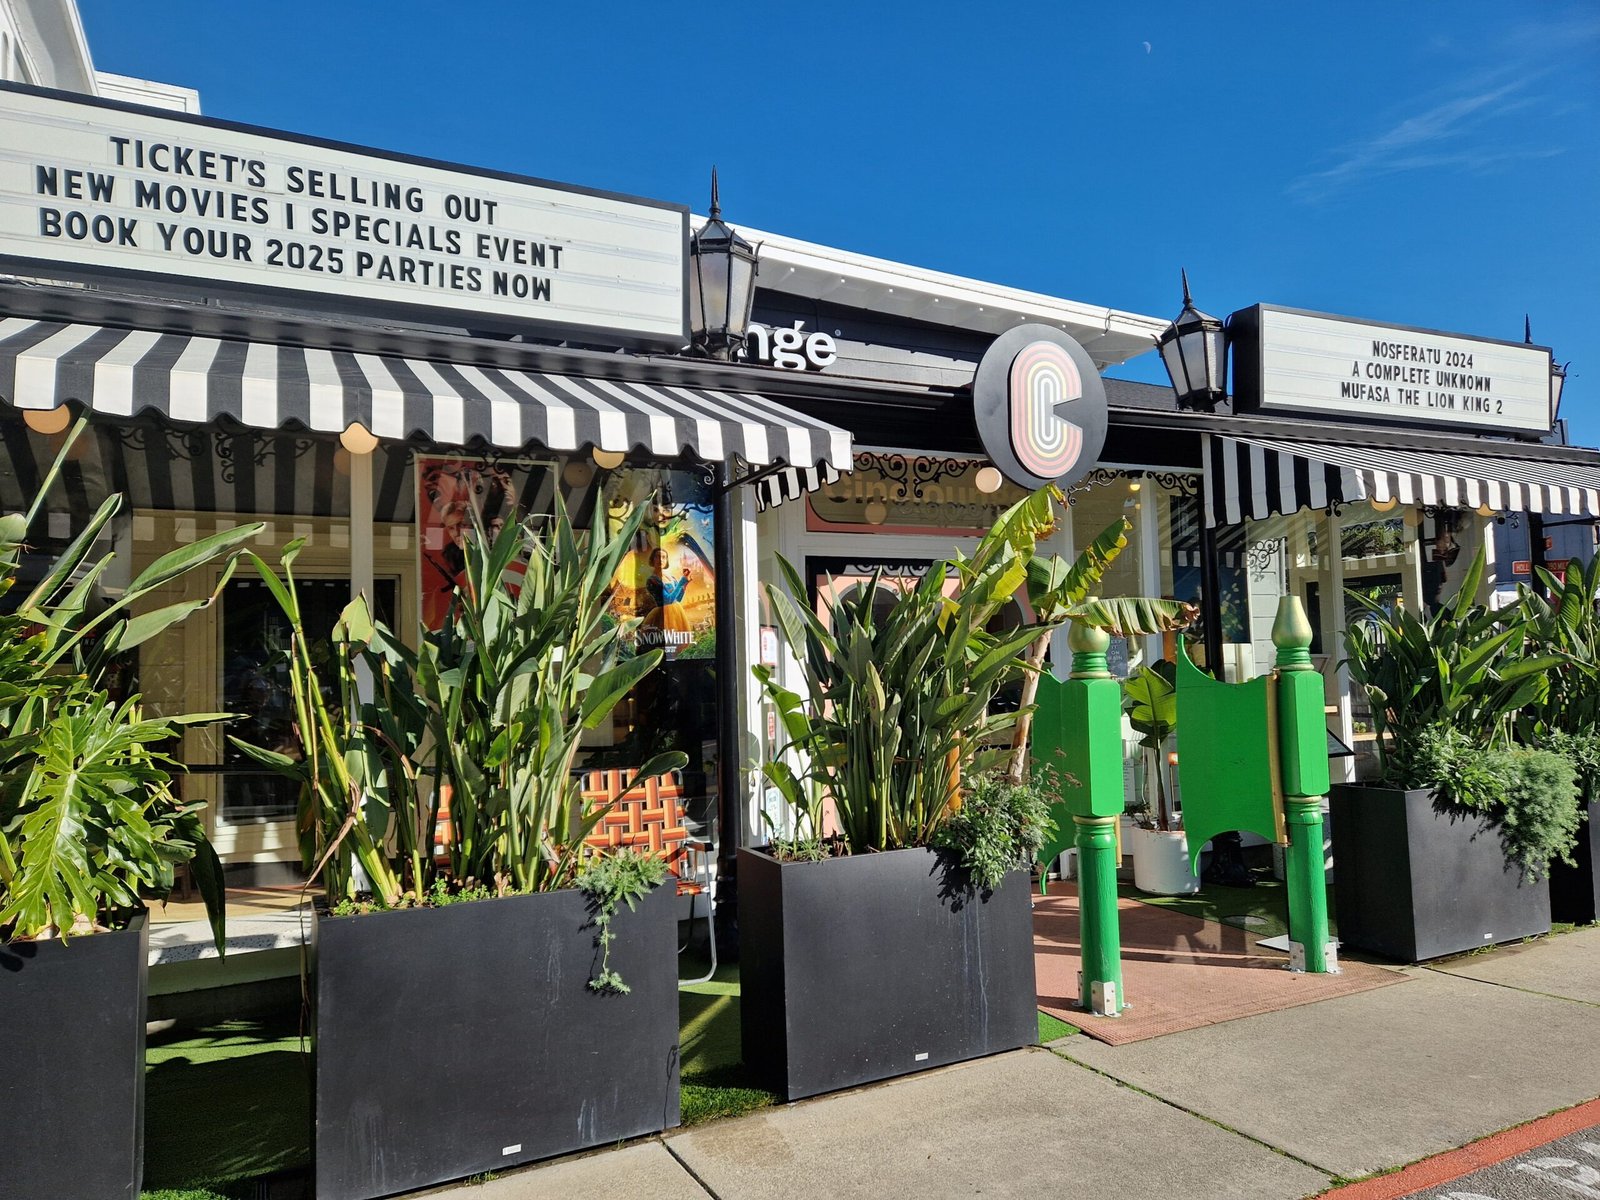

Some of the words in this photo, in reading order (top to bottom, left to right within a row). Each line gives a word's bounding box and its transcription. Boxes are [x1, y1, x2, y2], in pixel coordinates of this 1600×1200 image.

[109, 137, 266, 187] TICKET'S
[287, 167, 424, 212] SELLING
[444, 195, 498, 226] OUT
[37, 166, 114, 204] NEW
[135, 180, 269, 225] MOVIES
[311, 208, 461, 254] SPECIALS
[478, 234, 563, 270] EVENT
[40, 208, 137, 248] BOOK
[157, 223, 253, 262] YOUR
[266, 239, 344, 274] 2025
[356, 252, 482, 292] PARTIES
[493, 270, 551, 301] NOW
[1372, 340, 1441, 365] NOSFERATU
[1446, 351, 1473, 369] 2024
[1352, 361, 1360, 378] A
[1366, 362, 1430, 385] COMPLETE
[1436, 371, 1491, 392] UNKNOWN
[1341, 382, 1391, 403] MUFASA
[1397, 389, 1420, 406] THE
[1427, 391, 1455, 409] LION
[1463, 395, 1490, 413] KING
[1496, 400, 1503, 415] 2
[663, 628, 697, 645] WHITE
